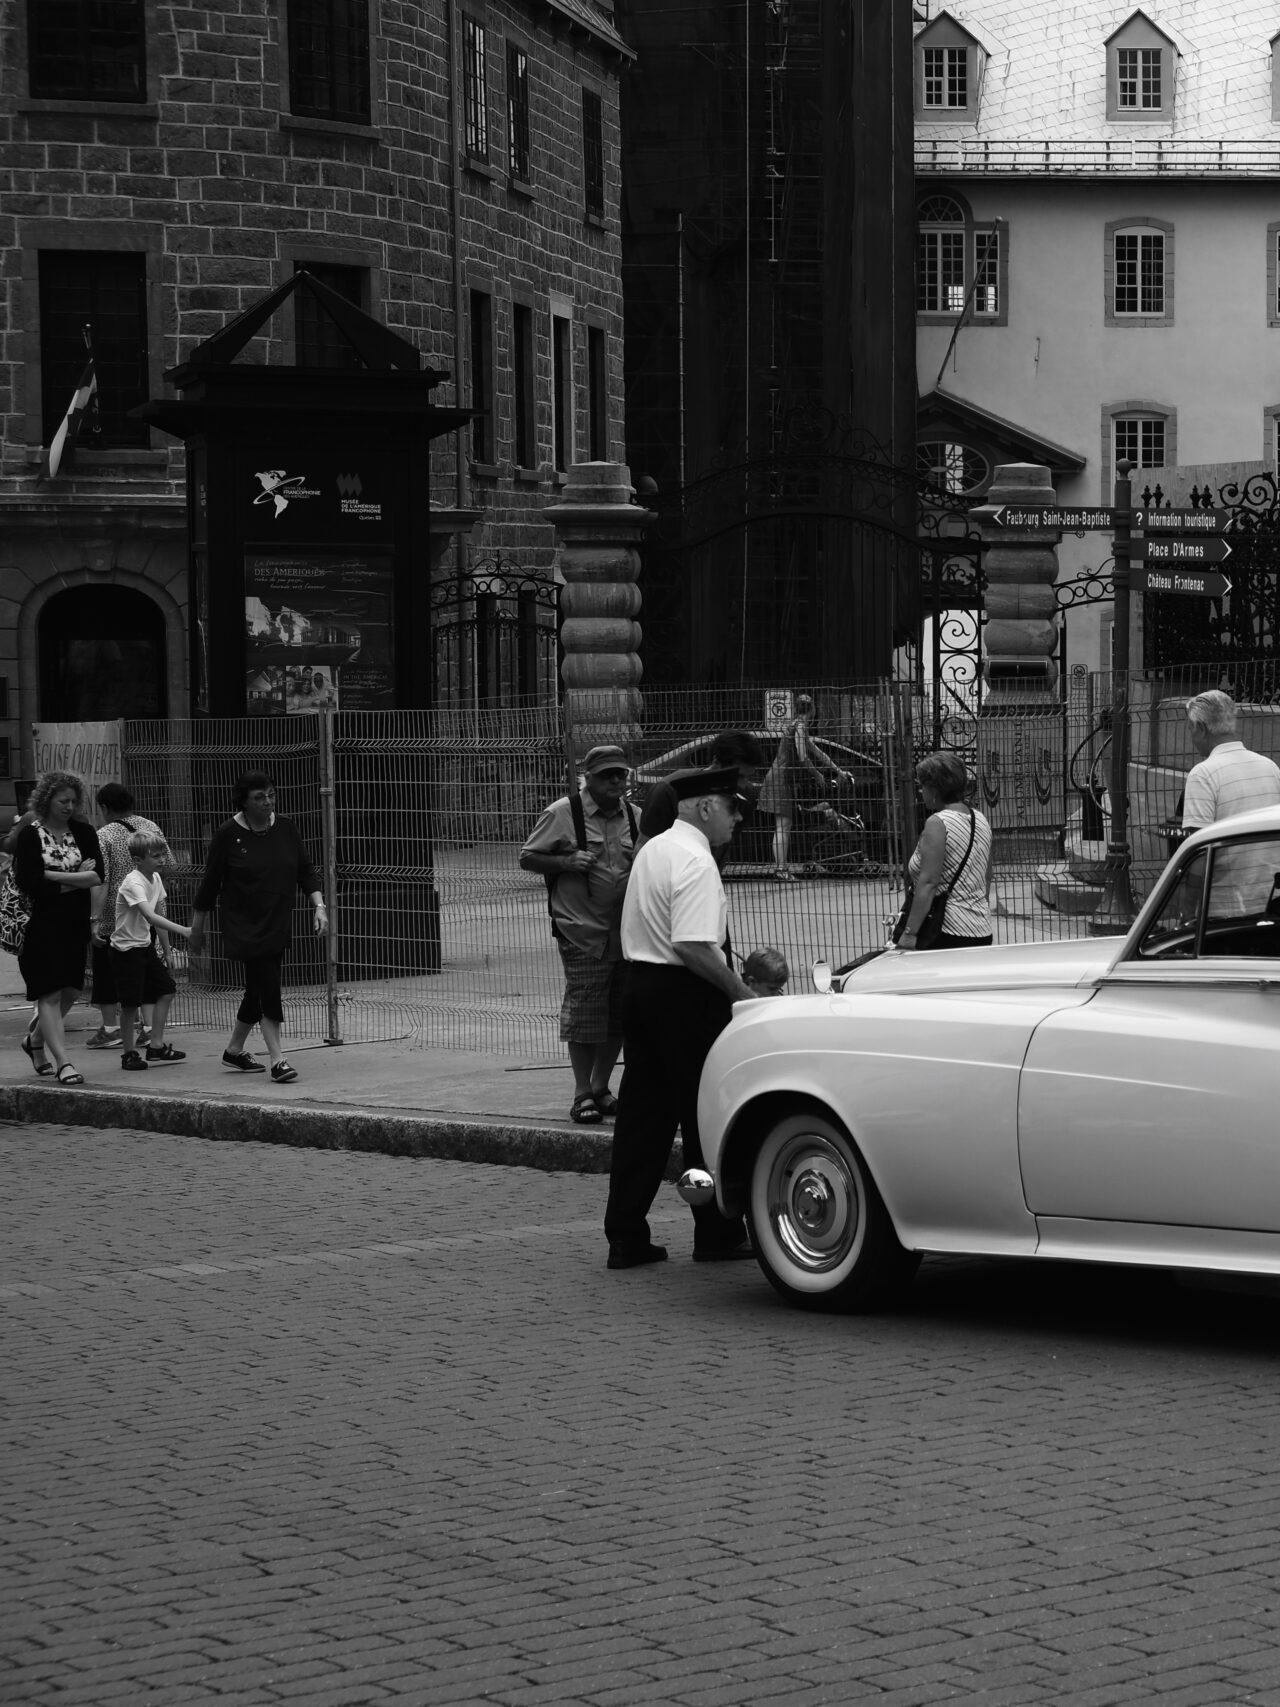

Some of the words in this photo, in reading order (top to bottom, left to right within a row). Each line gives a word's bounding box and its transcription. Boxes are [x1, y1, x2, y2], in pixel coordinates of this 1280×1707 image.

[1006, 510, 1039, 528] Faubourg
[1042, 510, 1110, 528] Saint-Jean-Baptiste
[1148, 512, 1182, 527] Information
[1184, 513, 1216, 531] touristique
[1148, 542, 1169, 557] Place
[1172, 542, 1204, 557] D'Armes
[254, 568, 270, 576] DES
[1147, 573, 1172, 589] Château
[72, 743, 119, 775] OUVERTE
